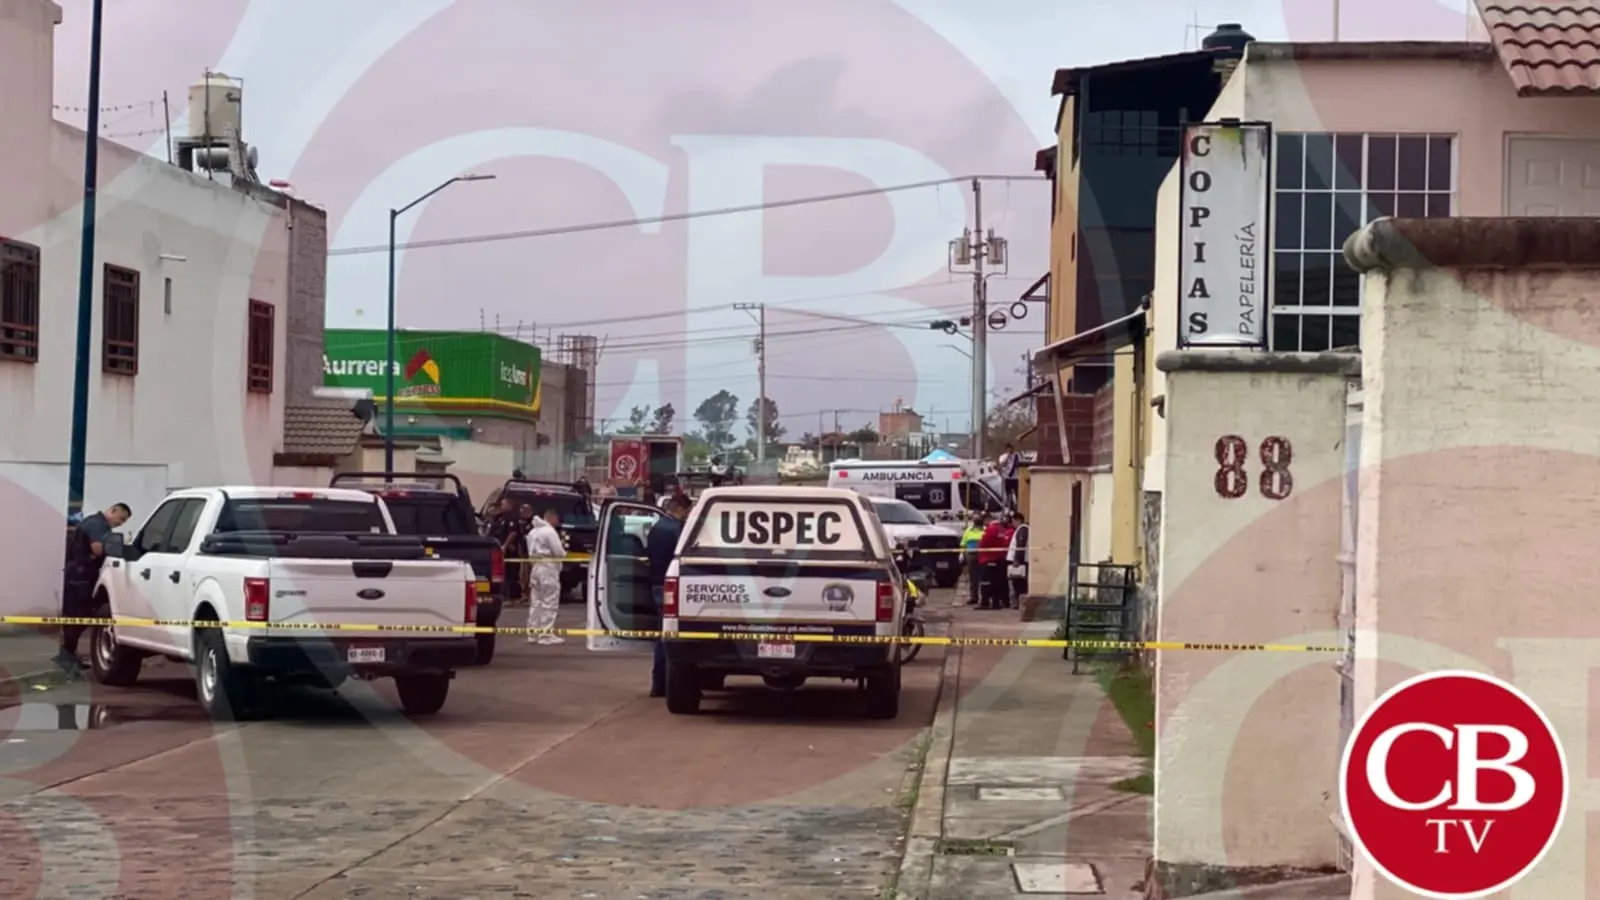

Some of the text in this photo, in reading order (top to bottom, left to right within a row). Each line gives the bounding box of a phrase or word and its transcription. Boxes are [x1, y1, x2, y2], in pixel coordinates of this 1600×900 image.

[1188, 135, 1211, 334] COPIAS
[1235, 222, 1255, 335] PAPELERÍA
[862, 471, 934, 481] AMBULANCIA
[1214, 434, 1293, 500] 88
[720, 511, 841, 545] USPEC
[686, 584, 746, 594] SERVICIOS
[686, 593, 750, 604] PERICIALES
